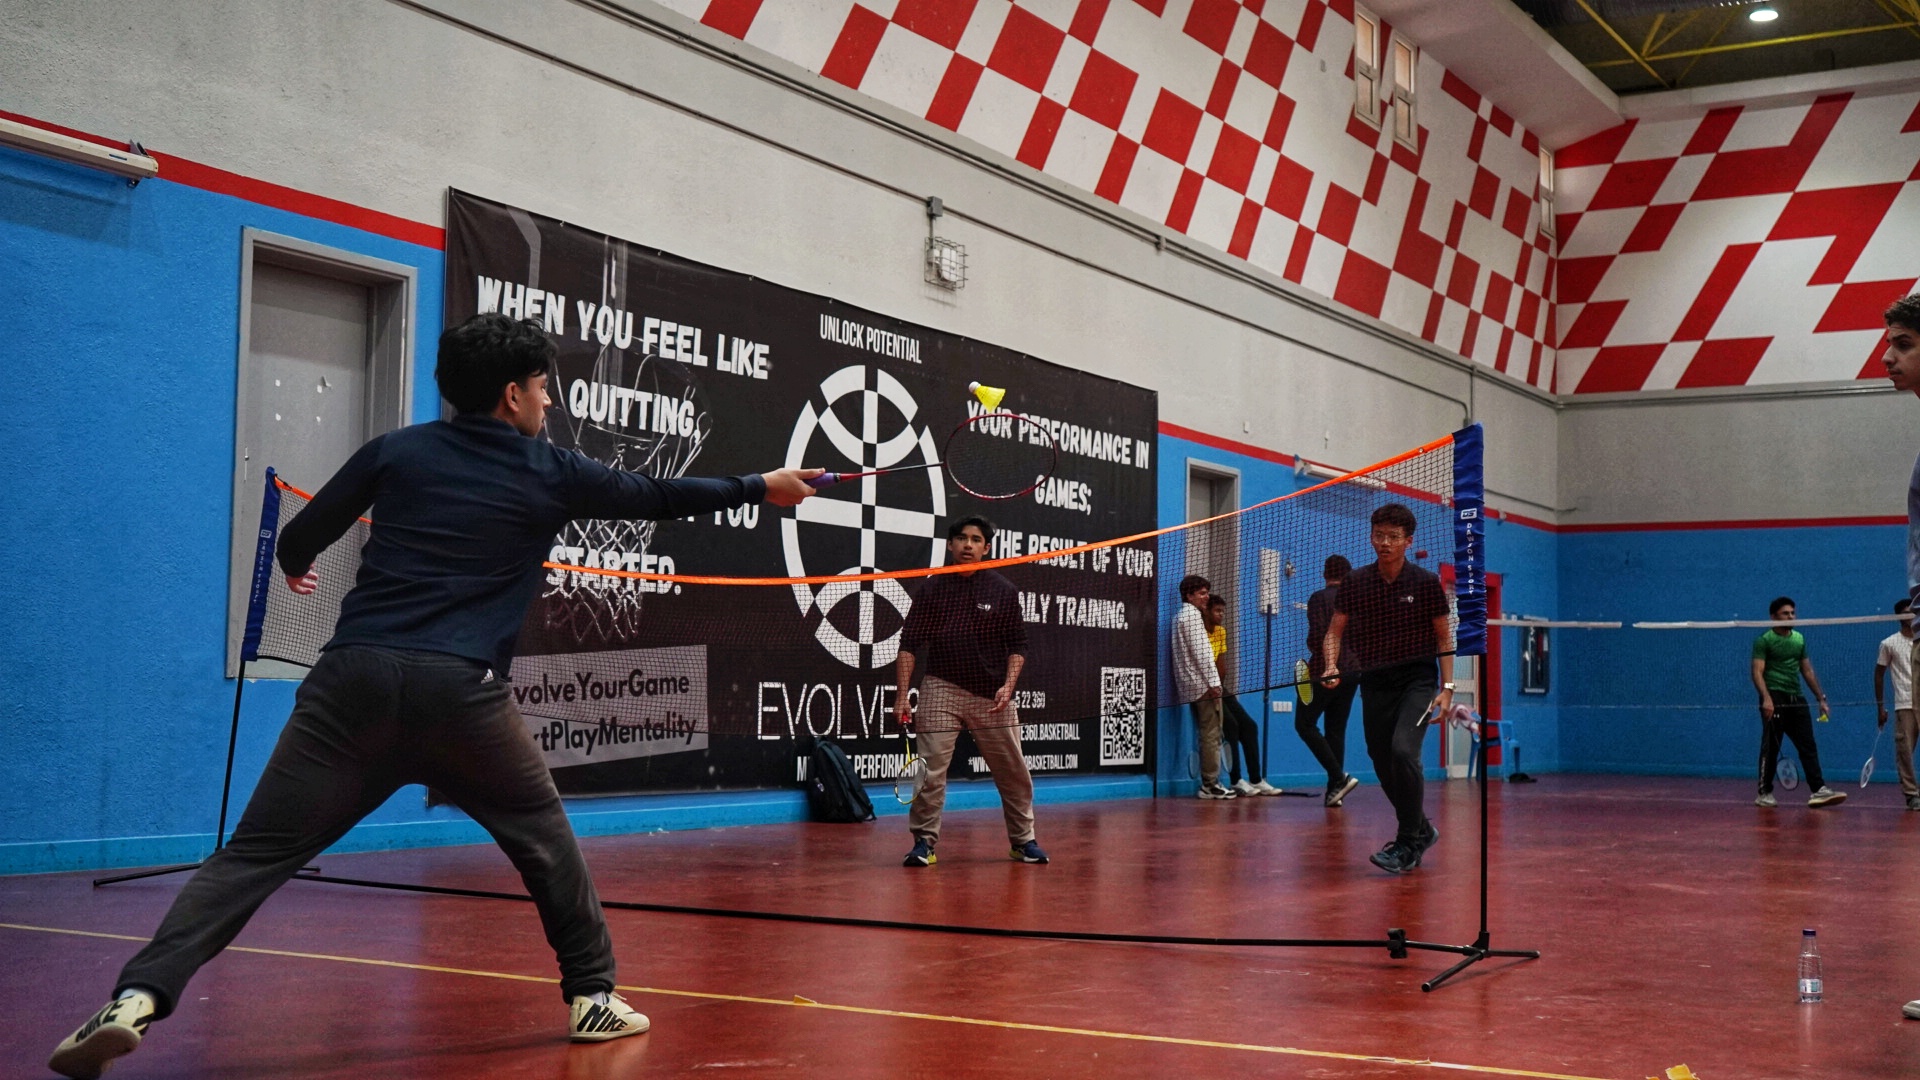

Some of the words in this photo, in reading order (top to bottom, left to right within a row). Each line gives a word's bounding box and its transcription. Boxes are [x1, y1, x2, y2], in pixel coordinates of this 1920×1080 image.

[477, 275, 566, 336] WHEN
[576, 300, 634, 349] YOU
[642, 317, 708, 367] FEEL
[717, 334, 770, 380] LIKE
[820, 313, 864, 349] UNLOCK
[866, 327, 922, 364] POTENTIAL
[569, 378, 702, 443] QUITTING,
[967, 400, 1013, 440] YOUR
[1018, 412, 1132, 465] PERFORMANCE
[1135, 440, 1150, 470] IN
[1034, 474, 1092, 516] GAMES;
[546, 545, 682, 596] STARTED.
[991, 528, 1023, 559] THE
[1028, 534, 1088, 571] RESULT
[1092, 546, 1112, 573] OF
[1116, 546, 1154, 578] YOUR
[1018, 591, 1051, 624] AILY
[1056, 595, 1129, 630] TRAINING.
[508, 668, 690, 706] volveYourGame
[533, 711, 697, 756] tPlayMentality
[577, 1003, 629, 1032] NIKE
